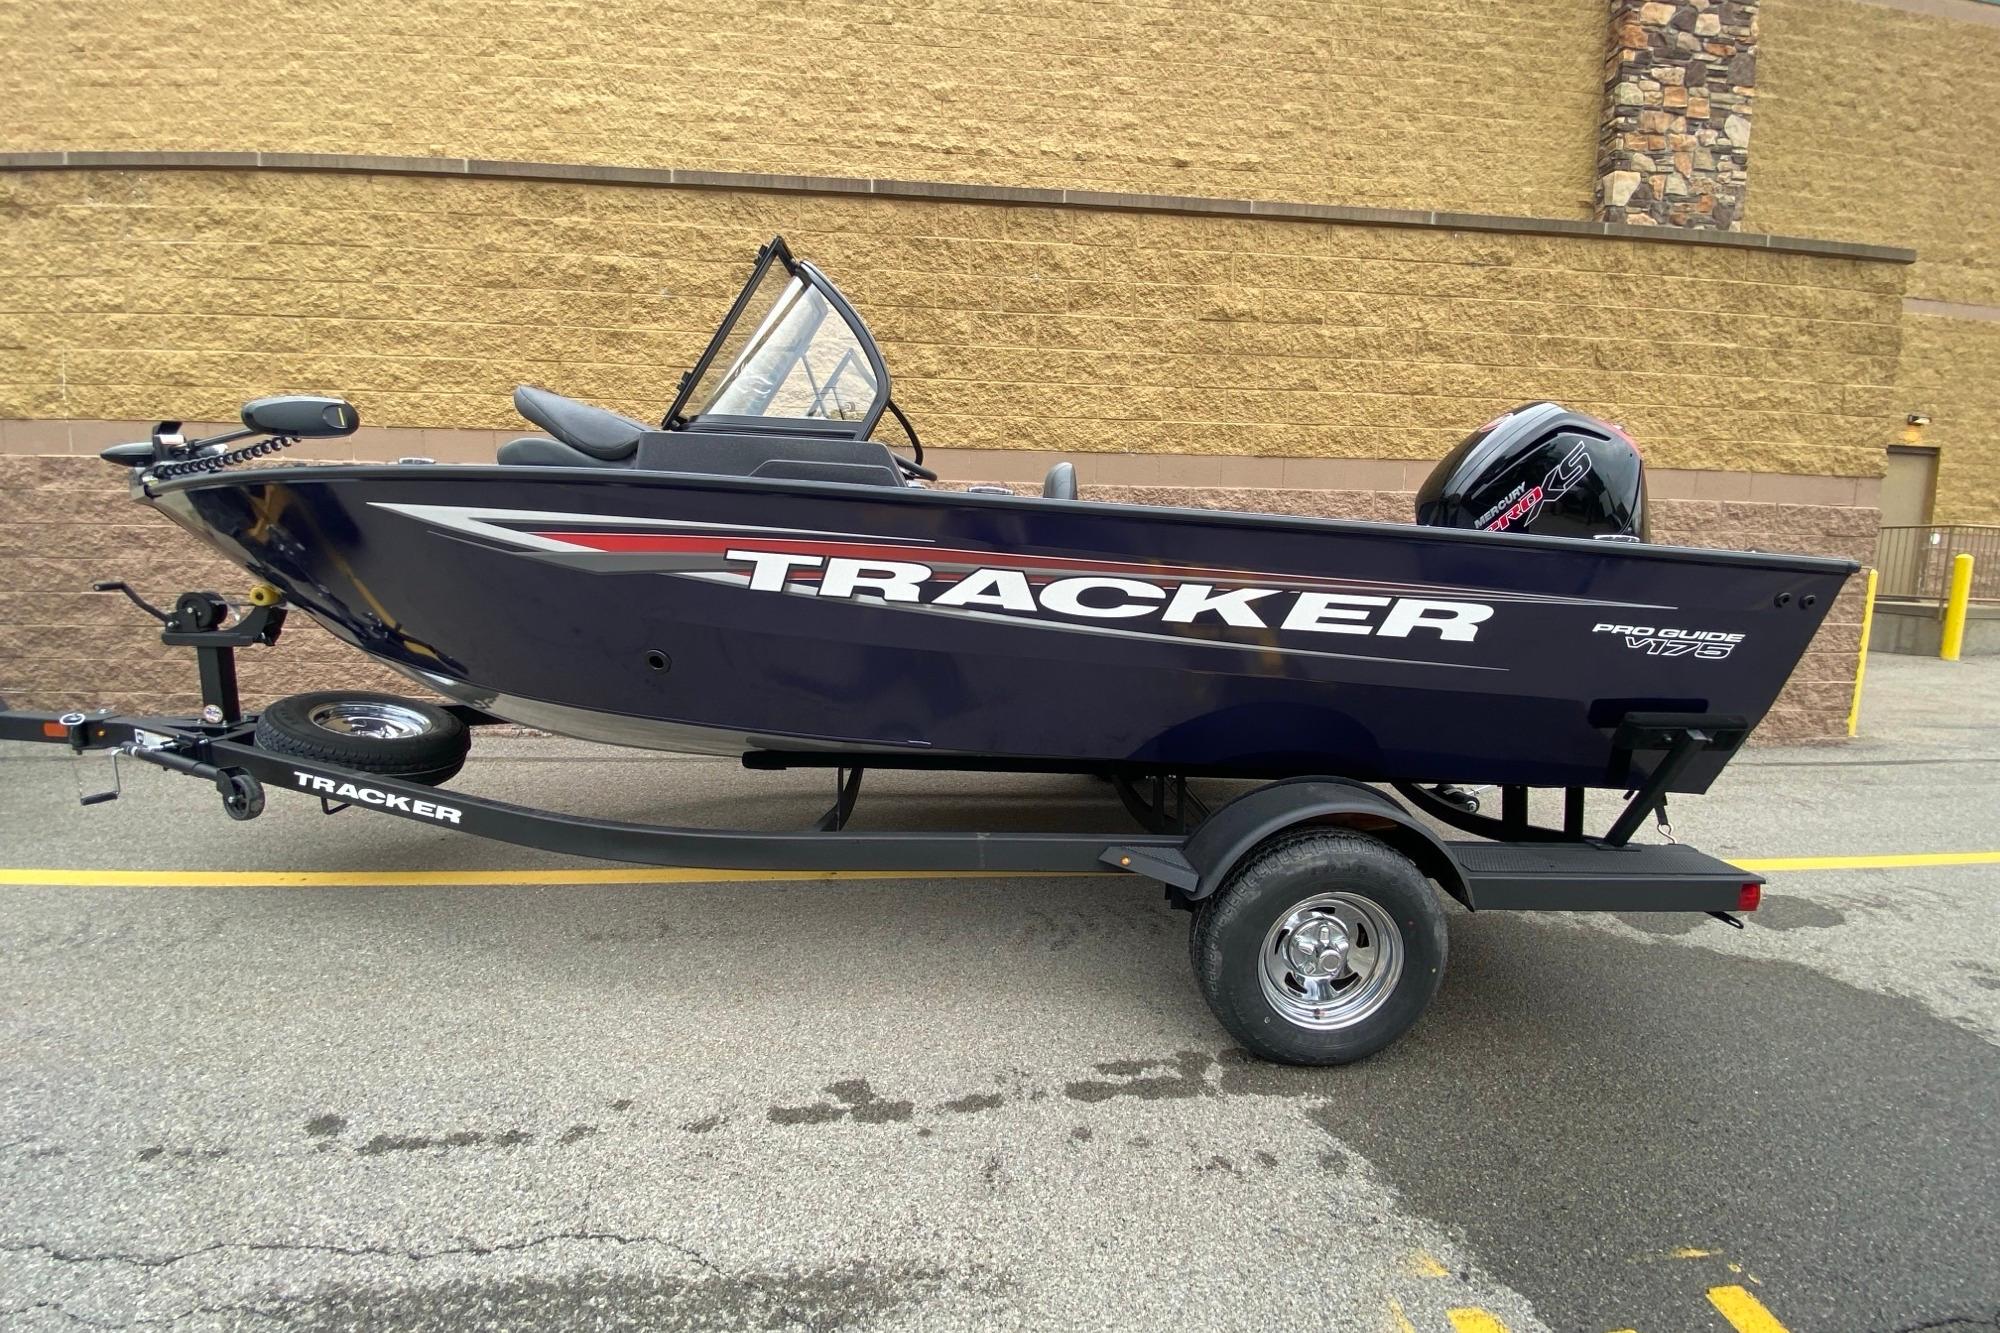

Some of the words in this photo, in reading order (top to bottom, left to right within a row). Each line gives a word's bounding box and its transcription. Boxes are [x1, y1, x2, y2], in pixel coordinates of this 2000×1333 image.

[1474, 482, 1526, 529] MERCURY
[1483, 486, 1543, 532] PRO
[1524, 441, 1592, 526] XS
[725, 551, 1494, 642] TRACKER
[1592, 623, 1655, 636] PRO
[1657, 628, 1746, 643] GUIDE
[1625, 636, 1735, 659] V175
[294, 771, 462, 824] TRACKER
